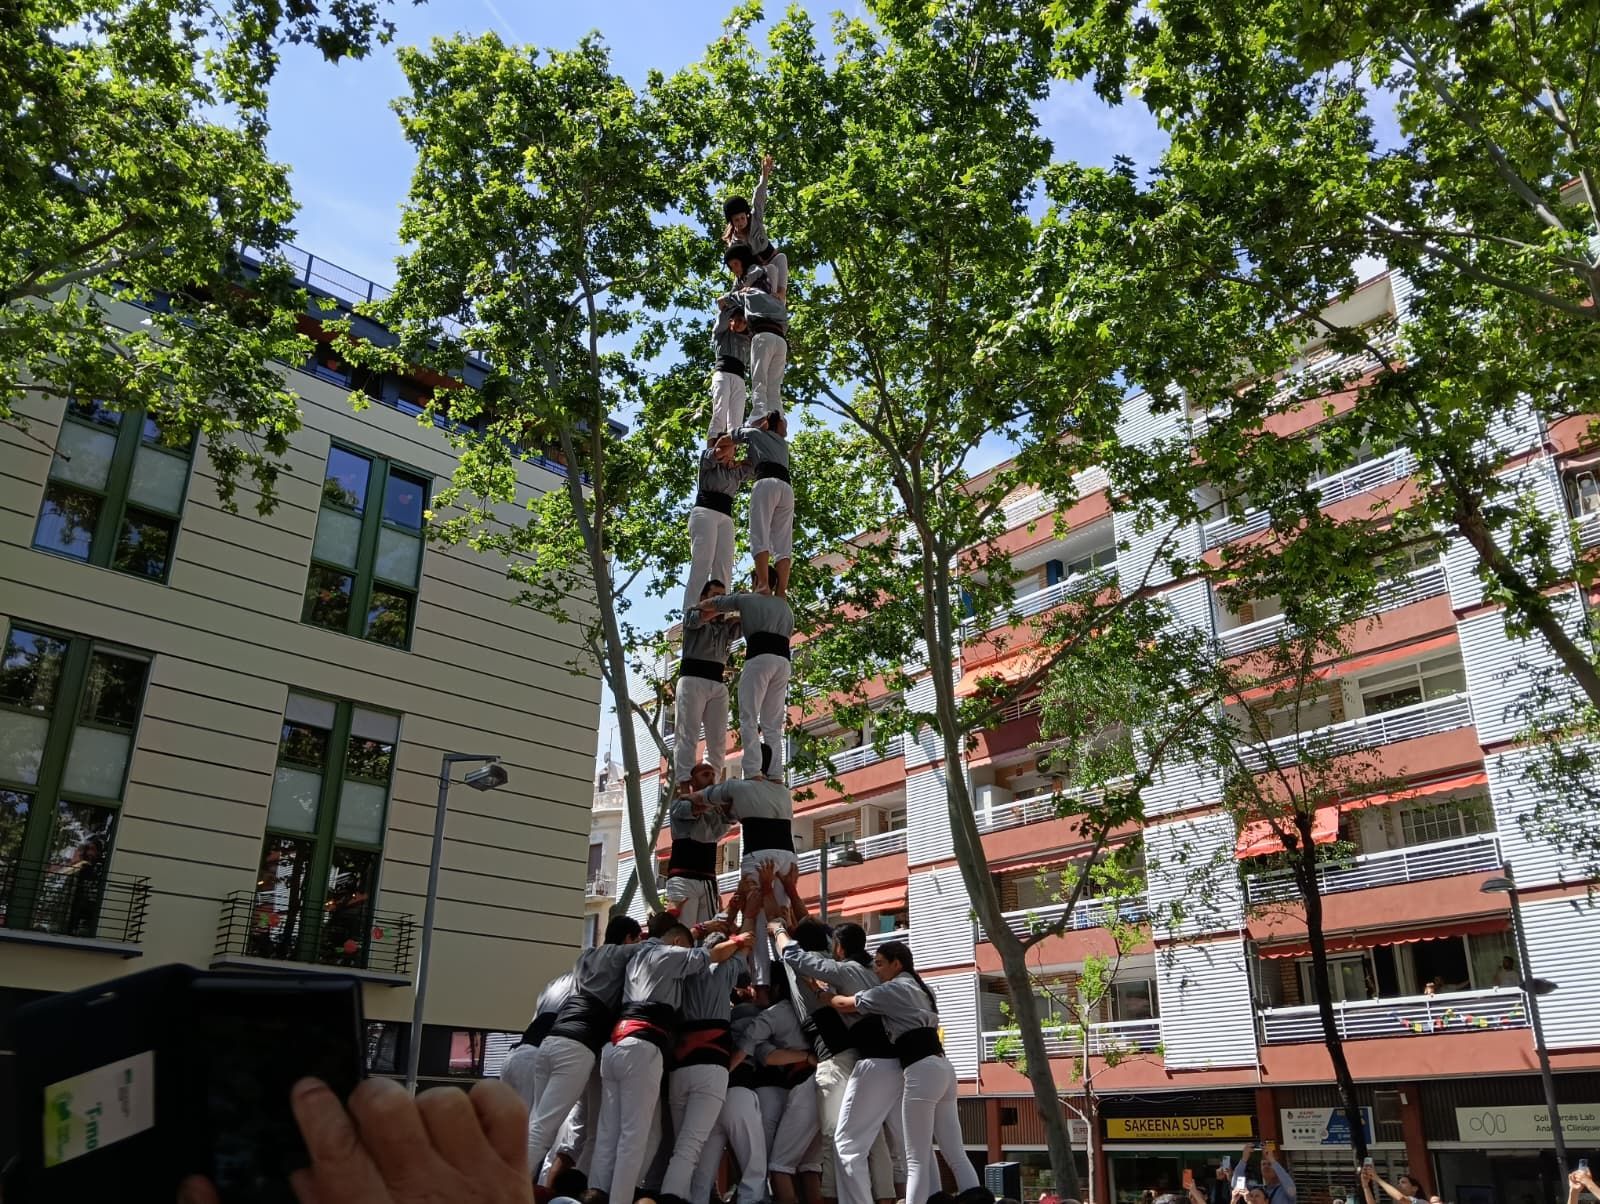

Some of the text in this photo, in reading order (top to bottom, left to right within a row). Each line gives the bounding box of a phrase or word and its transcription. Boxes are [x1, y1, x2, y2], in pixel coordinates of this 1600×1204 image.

[1580, 1113, 1596, 1121] Lab
[1124, 1117, 1225, 1132] SAKEENA SUPER
